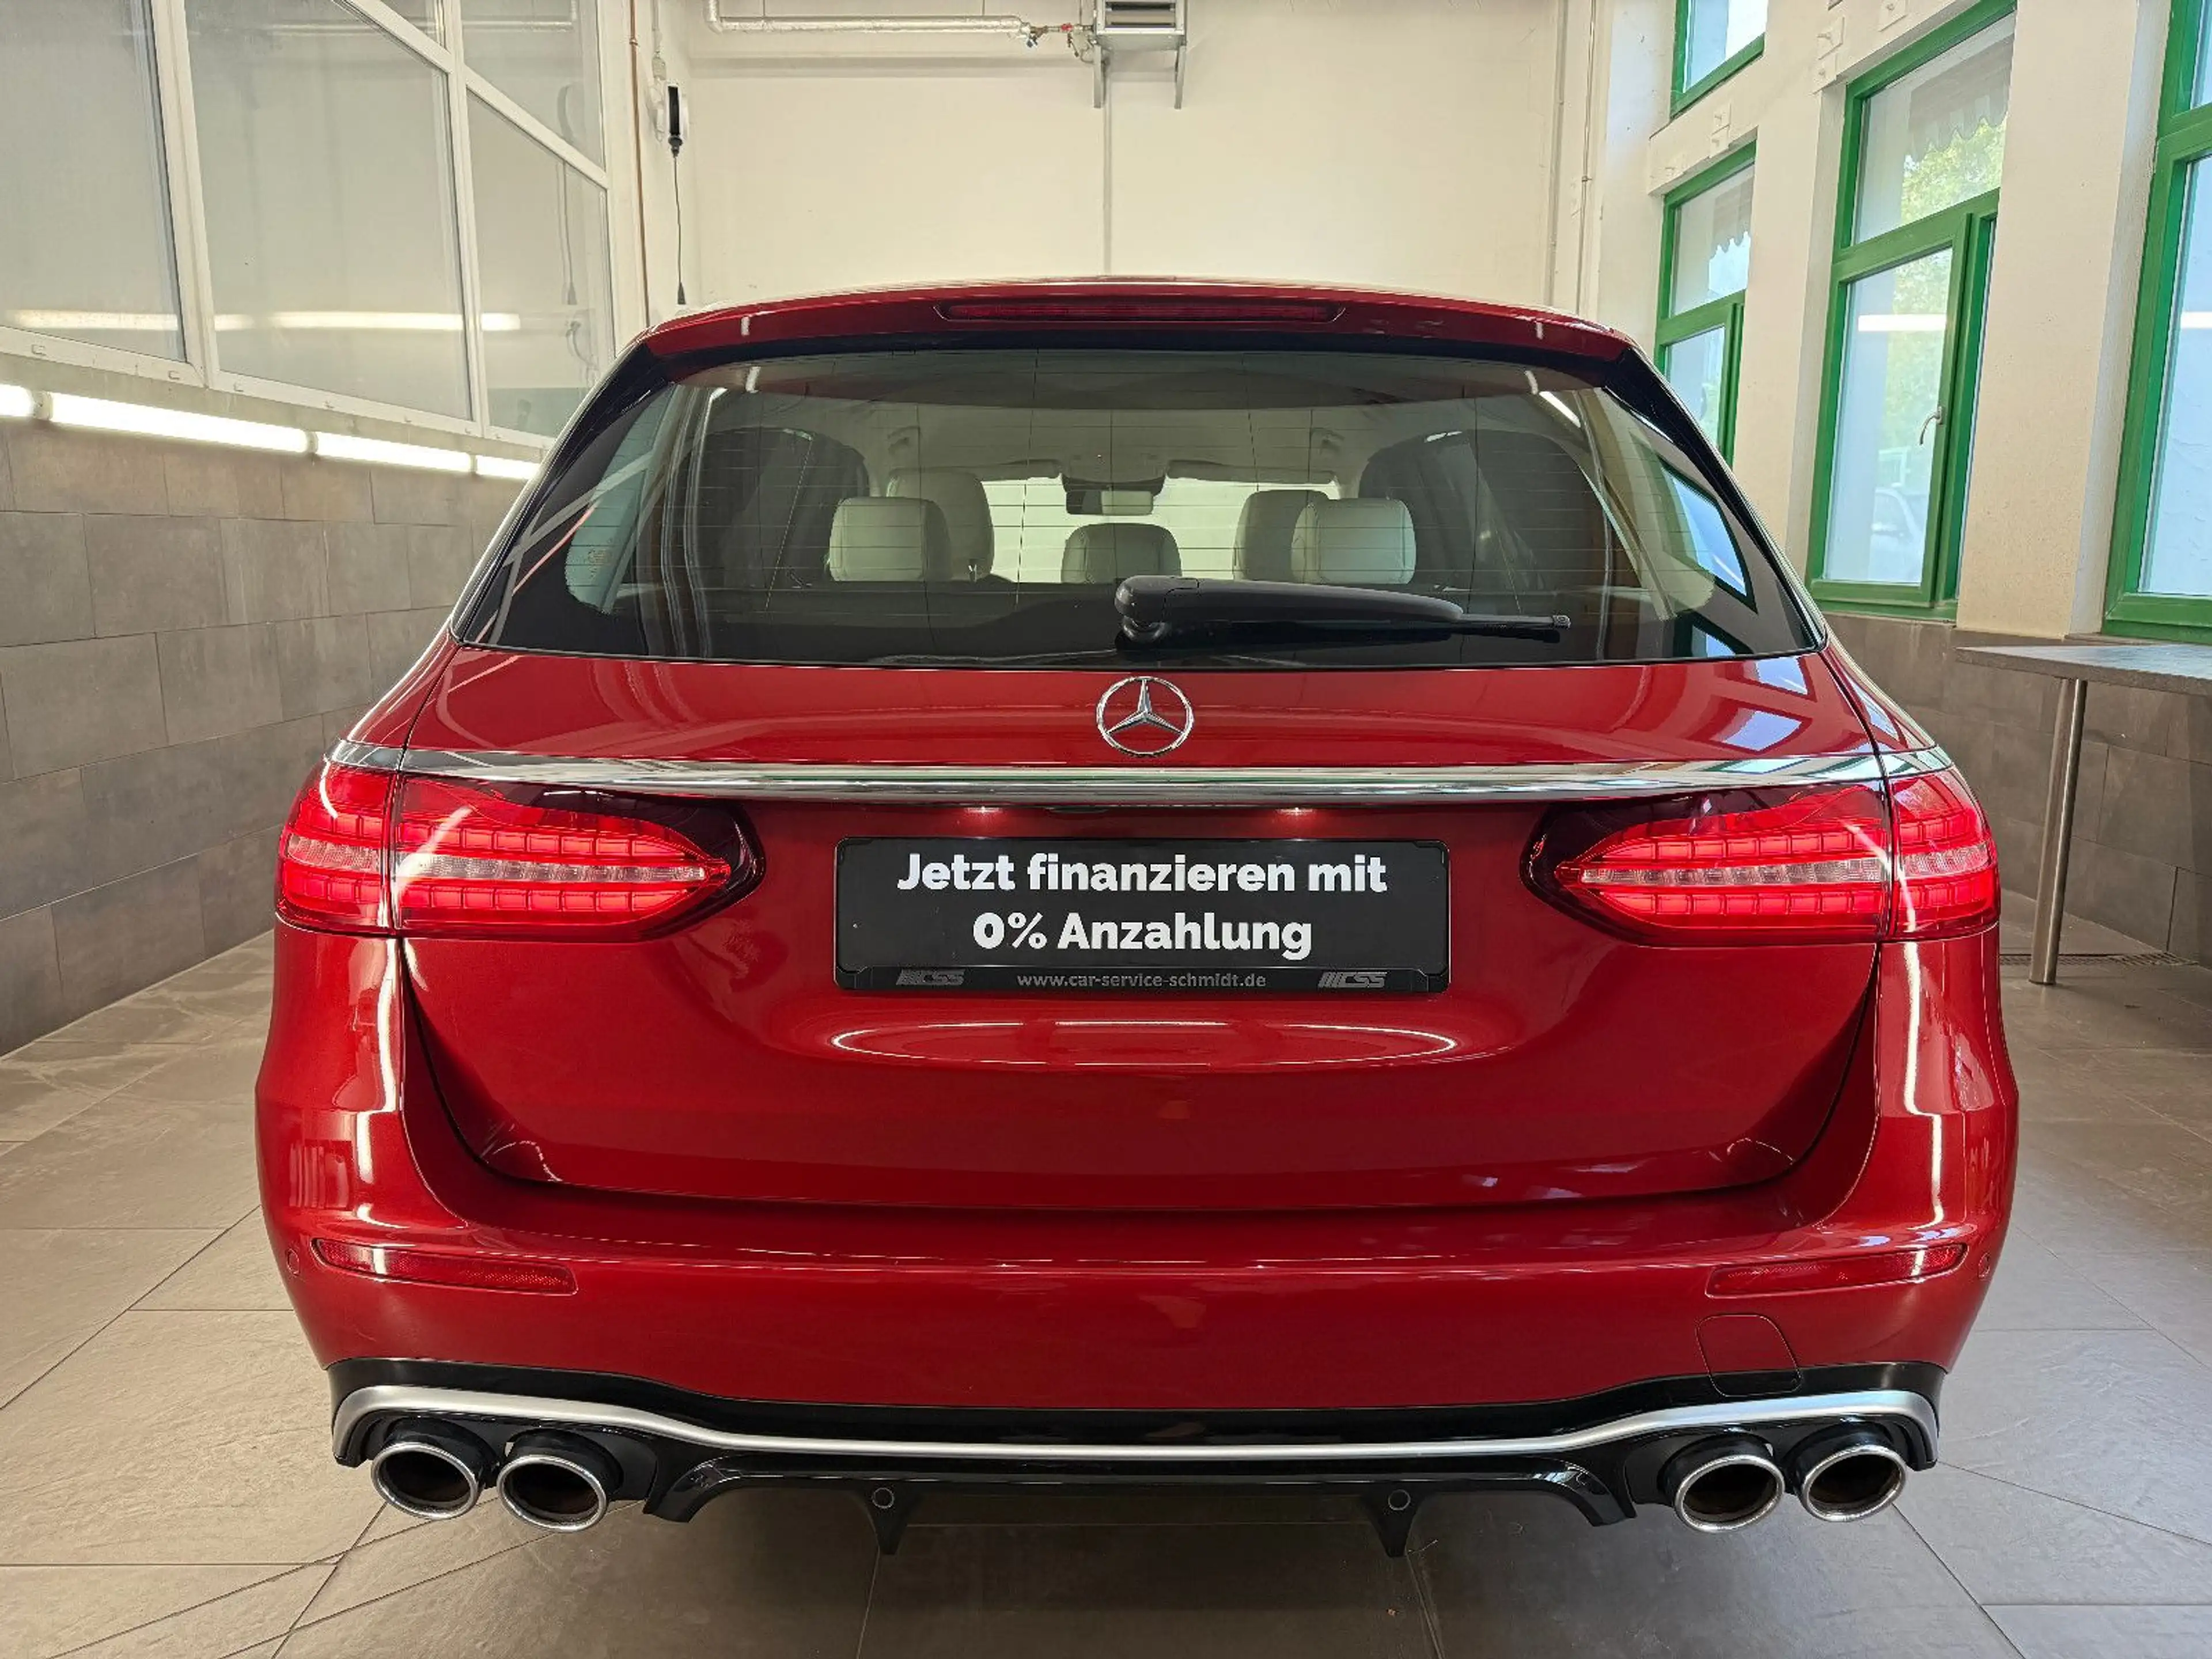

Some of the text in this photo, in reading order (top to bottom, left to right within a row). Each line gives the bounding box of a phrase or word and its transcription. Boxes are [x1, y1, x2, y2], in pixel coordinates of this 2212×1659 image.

[897, 853, 1388, 892] Jetzt finanzieren mit
[974, 912, 1312, 960] 0% Anzahlung
[1017, 973, 1266, 987] www.car-service-schmidt.de
